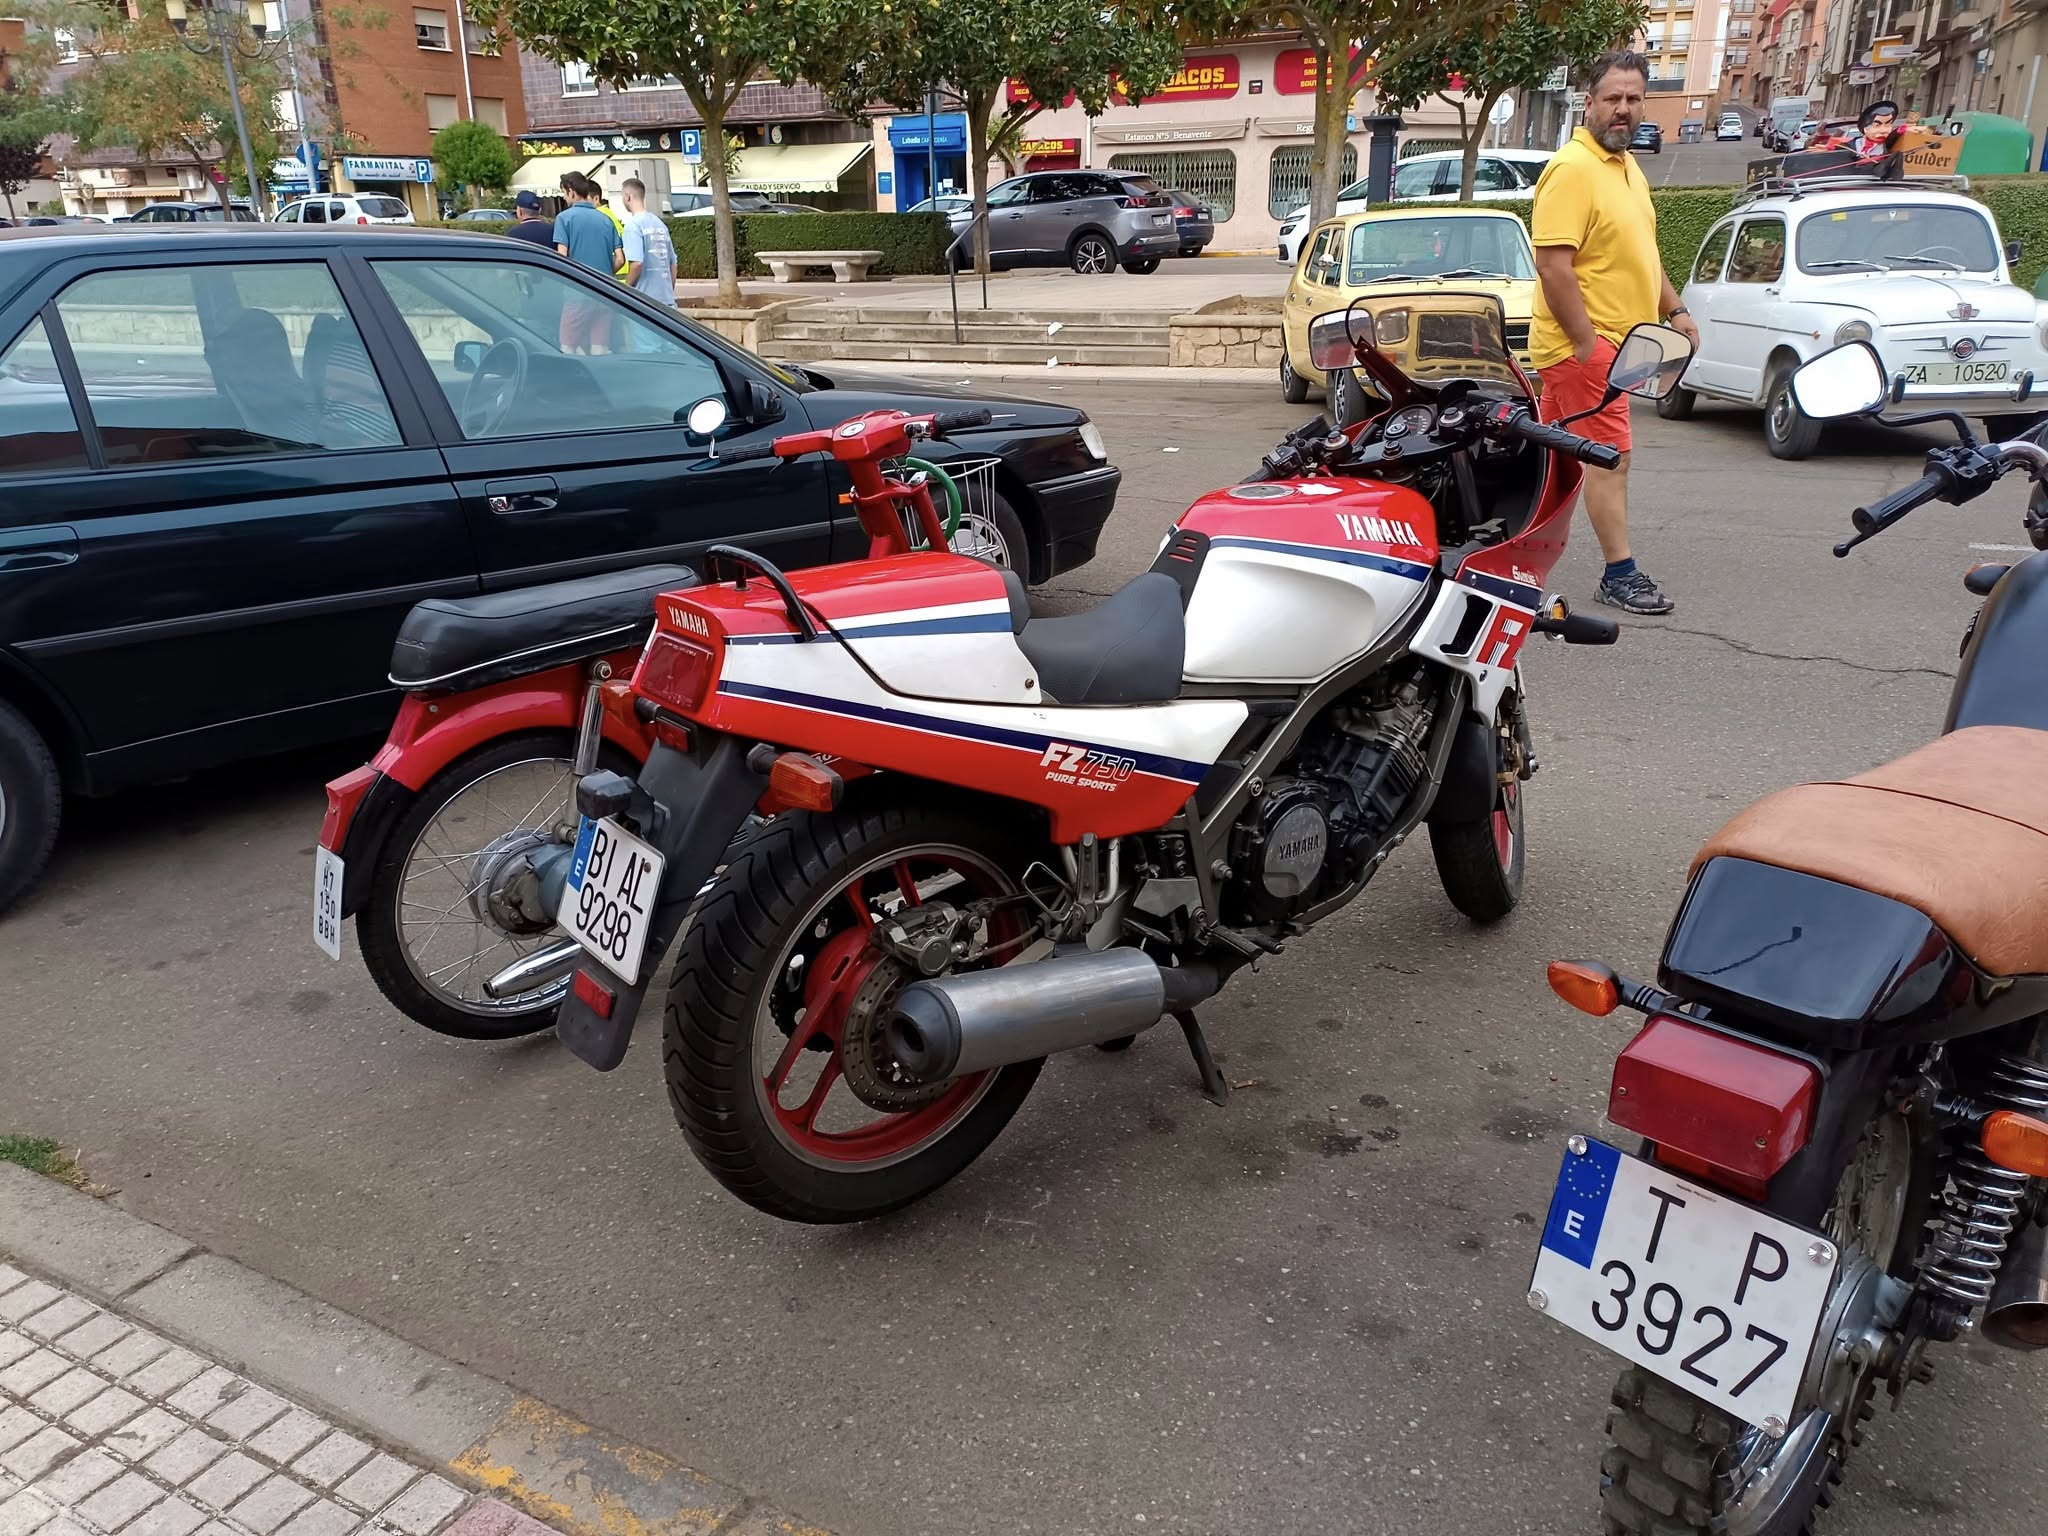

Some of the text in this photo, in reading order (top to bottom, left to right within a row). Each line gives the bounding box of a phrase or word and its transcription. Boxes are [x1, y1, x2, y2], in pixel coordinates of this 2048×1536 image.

[684, 133, 696, 152] P
[1124, 133, 1154, 141] Estanco
[1173, 130, 1212, 140] Benavente
[348, 160, 405, 170] FARMAVITAL
[418, 162, 427, 180] P
[741, 183, 766, 191] CALIDAD
[773, 182, 801, 190] SERVICIO
[1905, 362, 2007, 383] ZA 10520
[1335, 513, 1423, 547] YAMAHA
[667, 605, 710, 638] YAMAHA
[1045, 771, 1118, 792] PURE SPORTS
[1280, 834, 1320, 860] YAMAHA
[573, 858, 584, 878] E
[587, 827, 645, 915] BI AL
[320, 891, 336, 919] 150
[576, 882, 632, 962] 9298
[1563, 1208, 1585, 1239] E
[1645, 1185, 1789, 1305] T P
[1591, 1259, 1789, 1398] 3927
